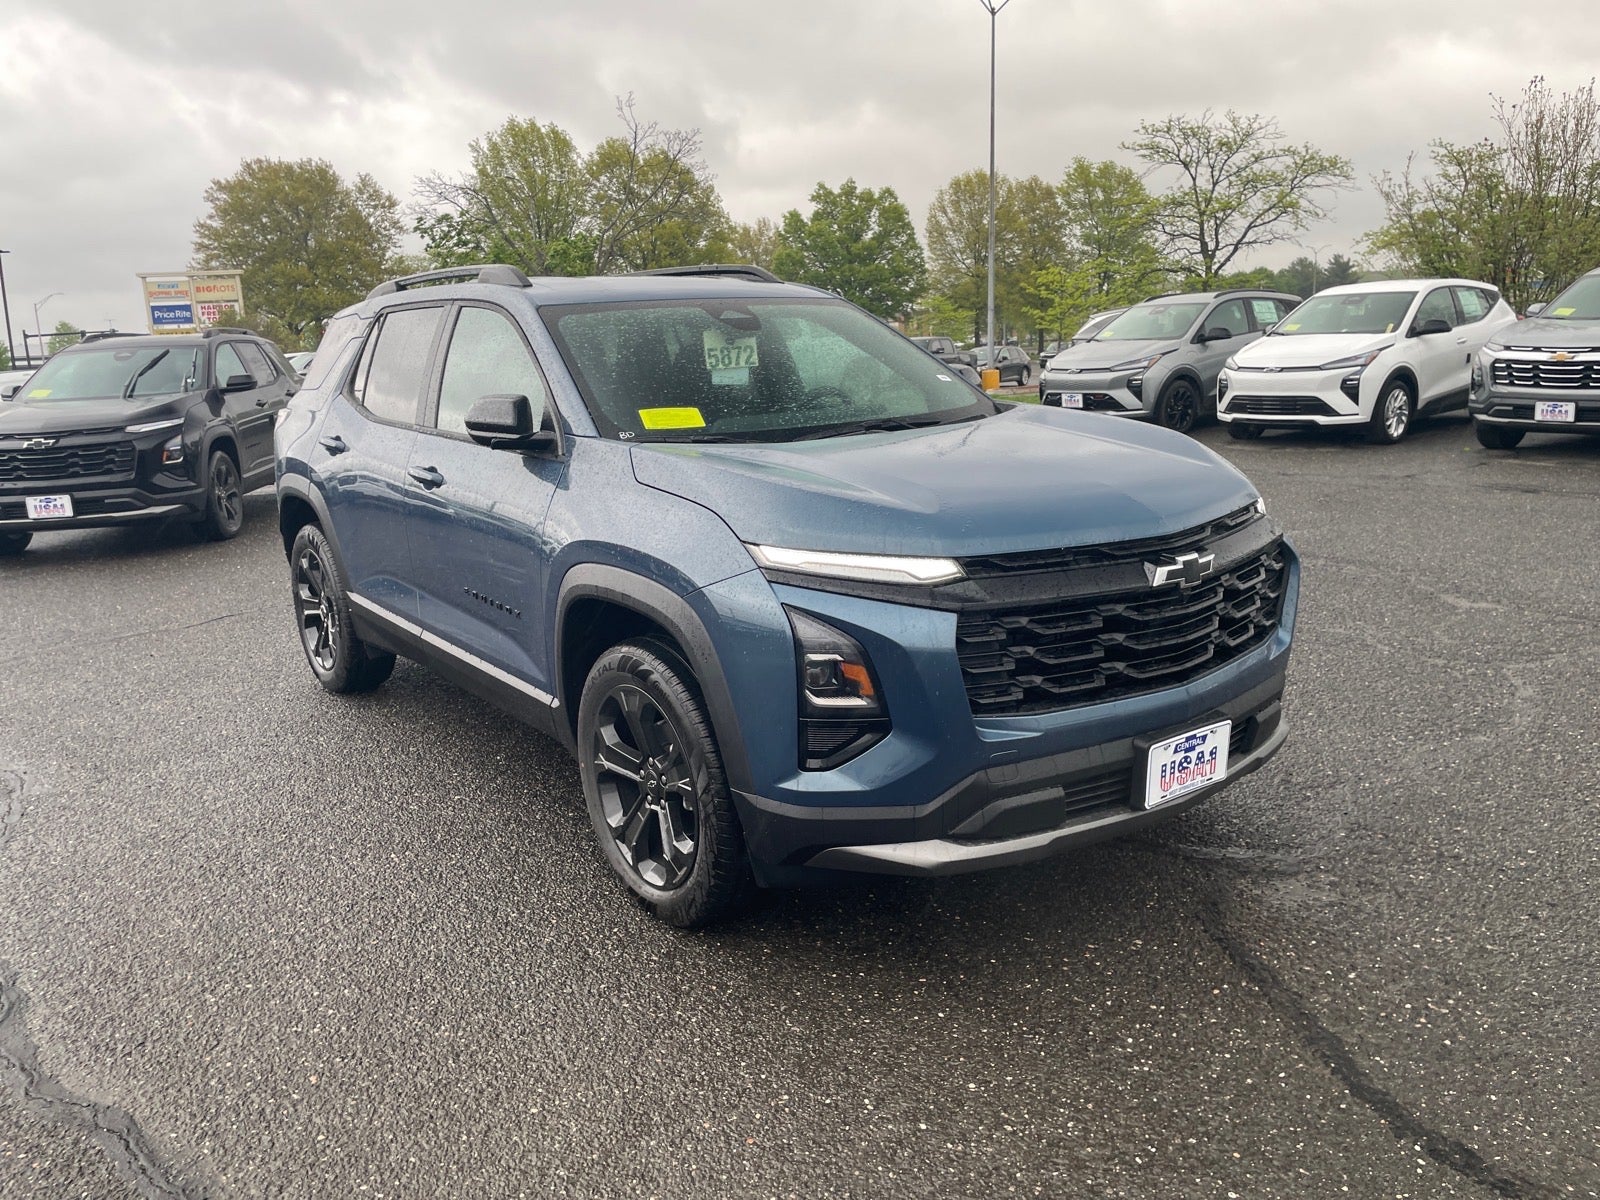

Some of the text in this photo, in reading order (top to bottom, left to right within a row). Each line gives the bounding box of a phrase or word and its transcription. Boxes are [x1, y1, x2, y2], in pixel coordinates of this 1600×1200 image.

[154, 309, 191, 319] Price Rite
[707, 345, 757, 368] 5872
[1176, 738, 1204, 752] CENTRAL
